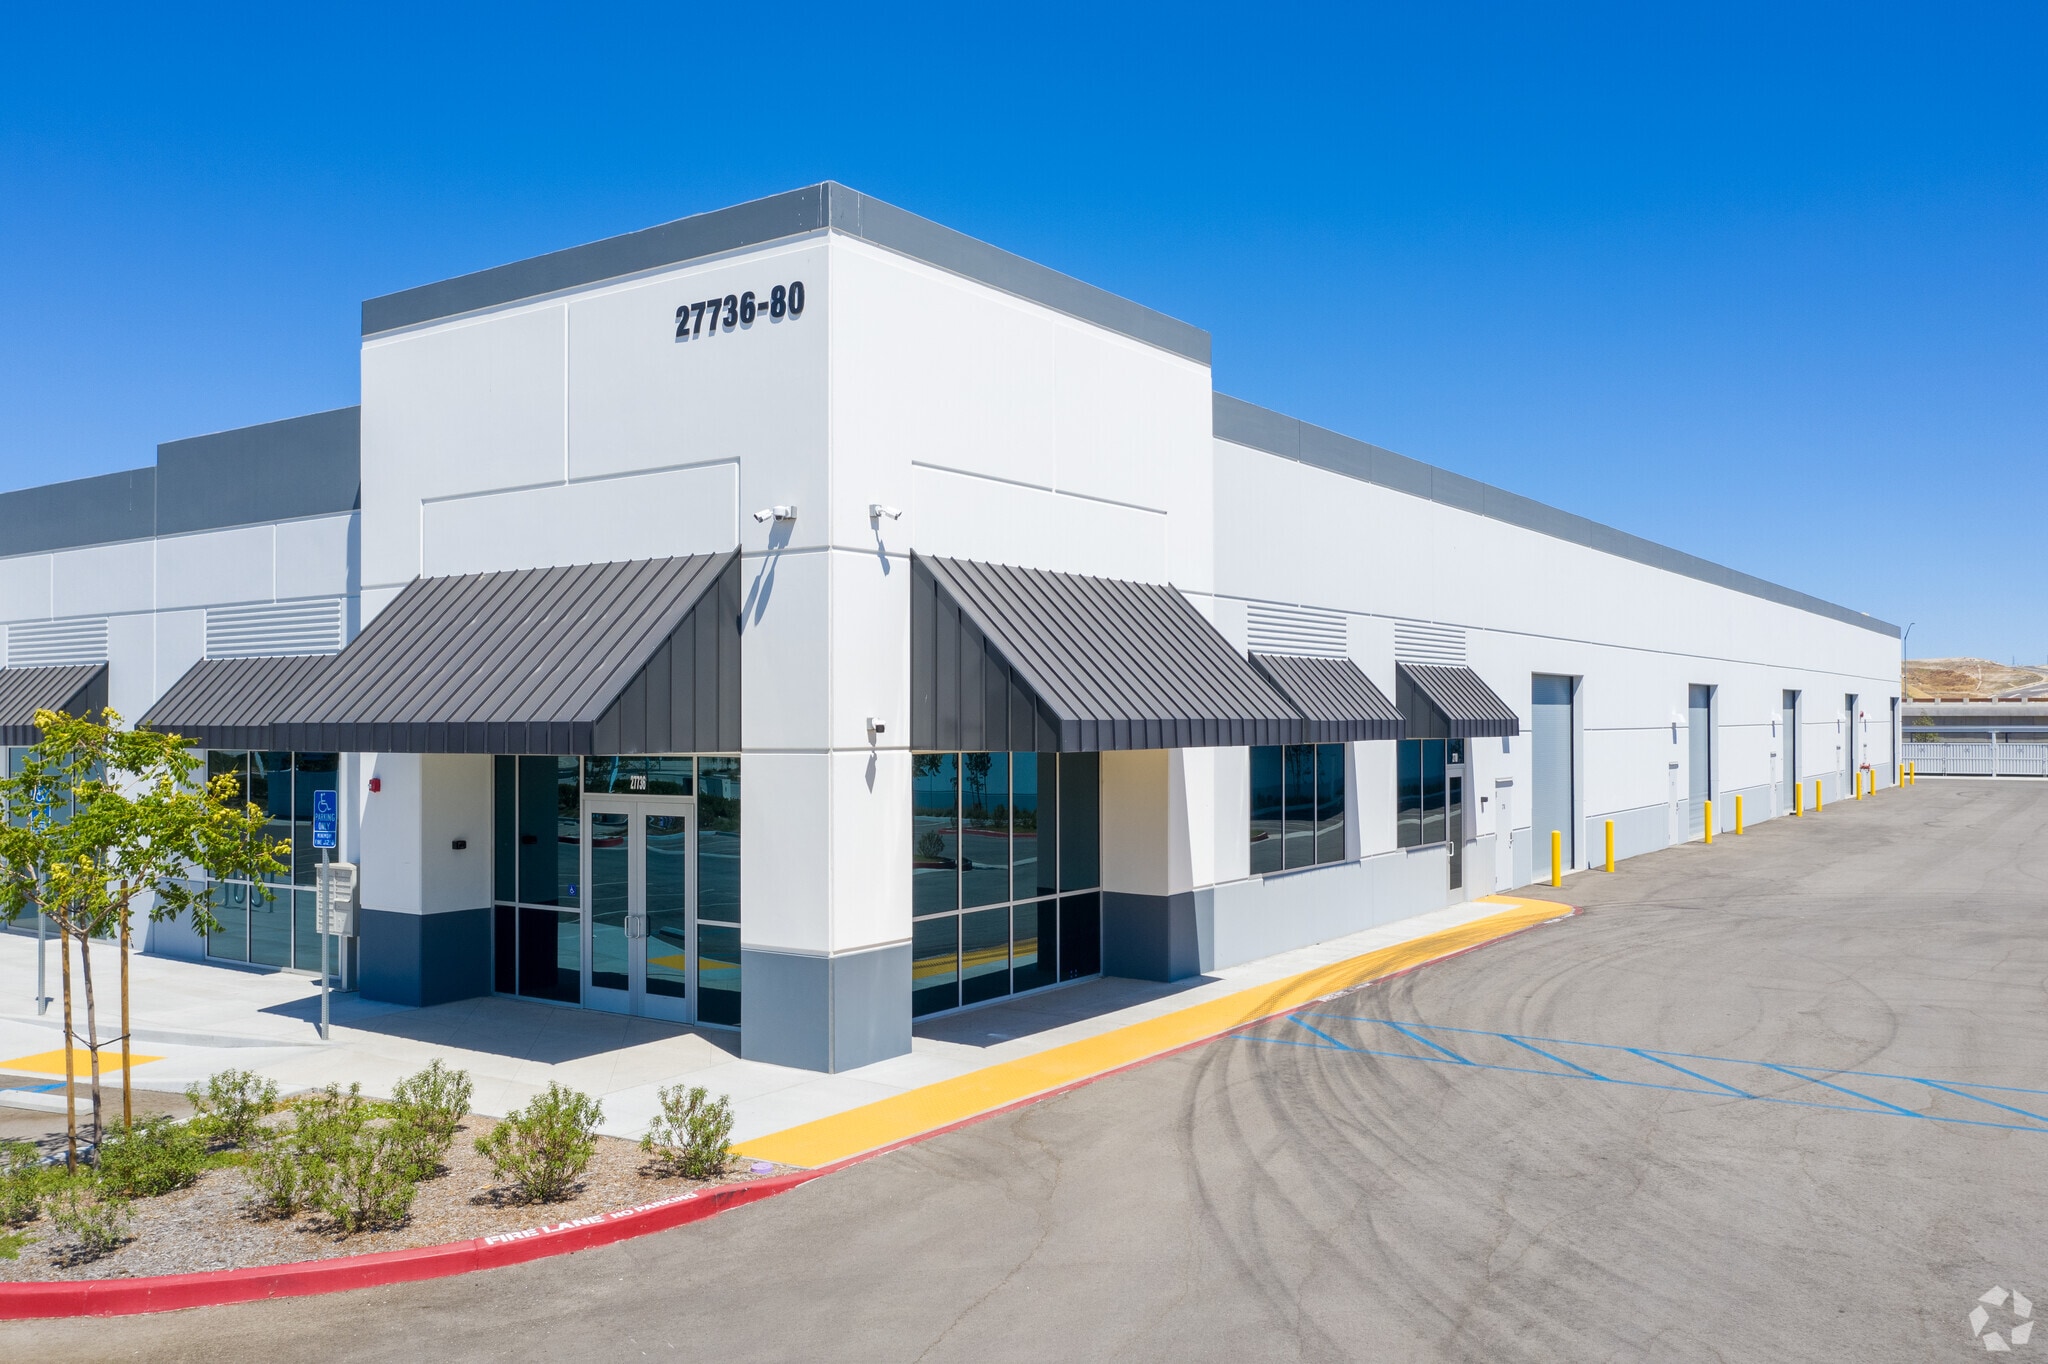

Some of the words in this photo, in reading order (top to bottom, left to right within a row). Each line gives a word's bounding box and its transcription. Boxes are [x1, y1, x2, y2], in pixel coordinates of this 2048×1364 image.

[676, 281, 805, 338] 27736-80
[630, 775, 647, 790] 27736
[484, 1228, 540, 1246] FIRE
[541, 1215, 605, 1234] LANE
[609, 1209, 634, 1219] NO
[634, 1193, 699, 1212] PARKING
